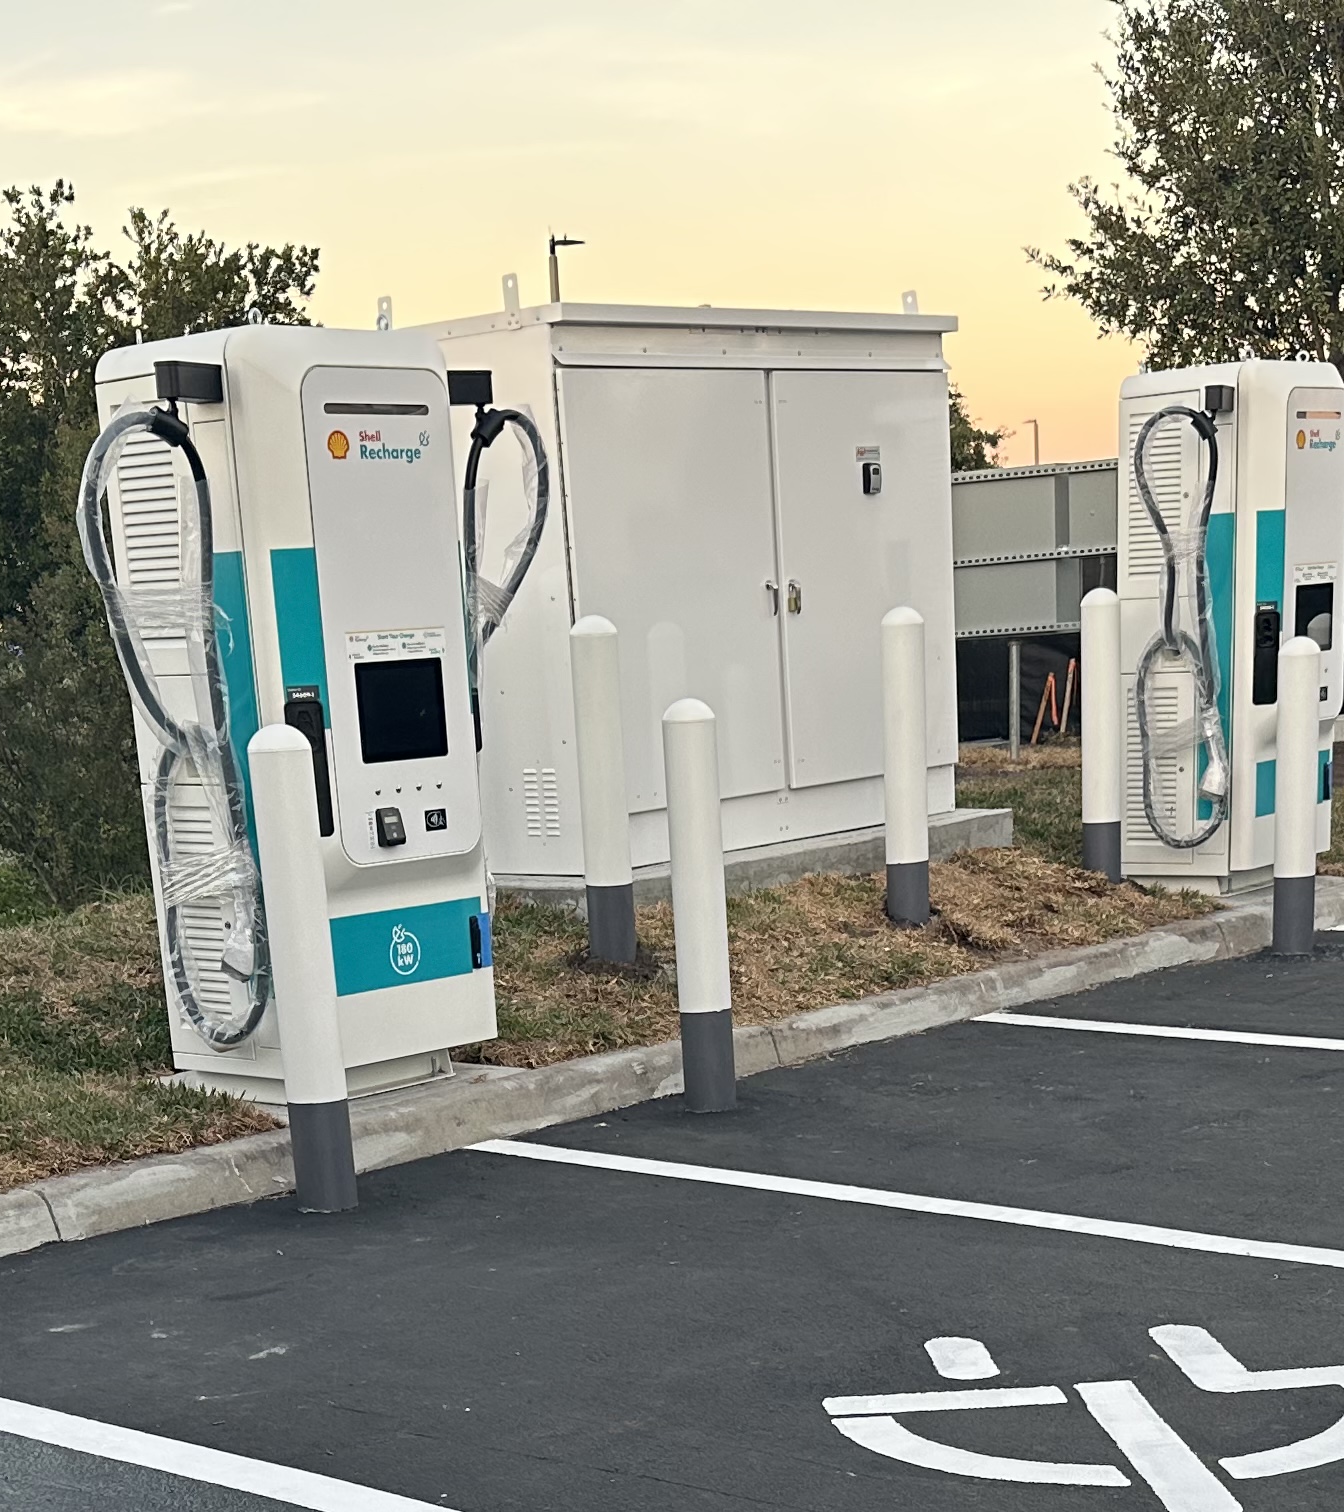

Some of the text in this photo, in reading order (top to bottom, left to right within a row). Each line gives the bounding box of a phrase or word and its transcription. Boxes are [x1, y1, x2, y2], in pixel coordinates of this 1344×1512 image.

[359, 430, 381, 442] Shell
[359, 443, 422, 464] Recharge
[397, 942, 413, 955] 180
[397, 953, 414, 967] kW
